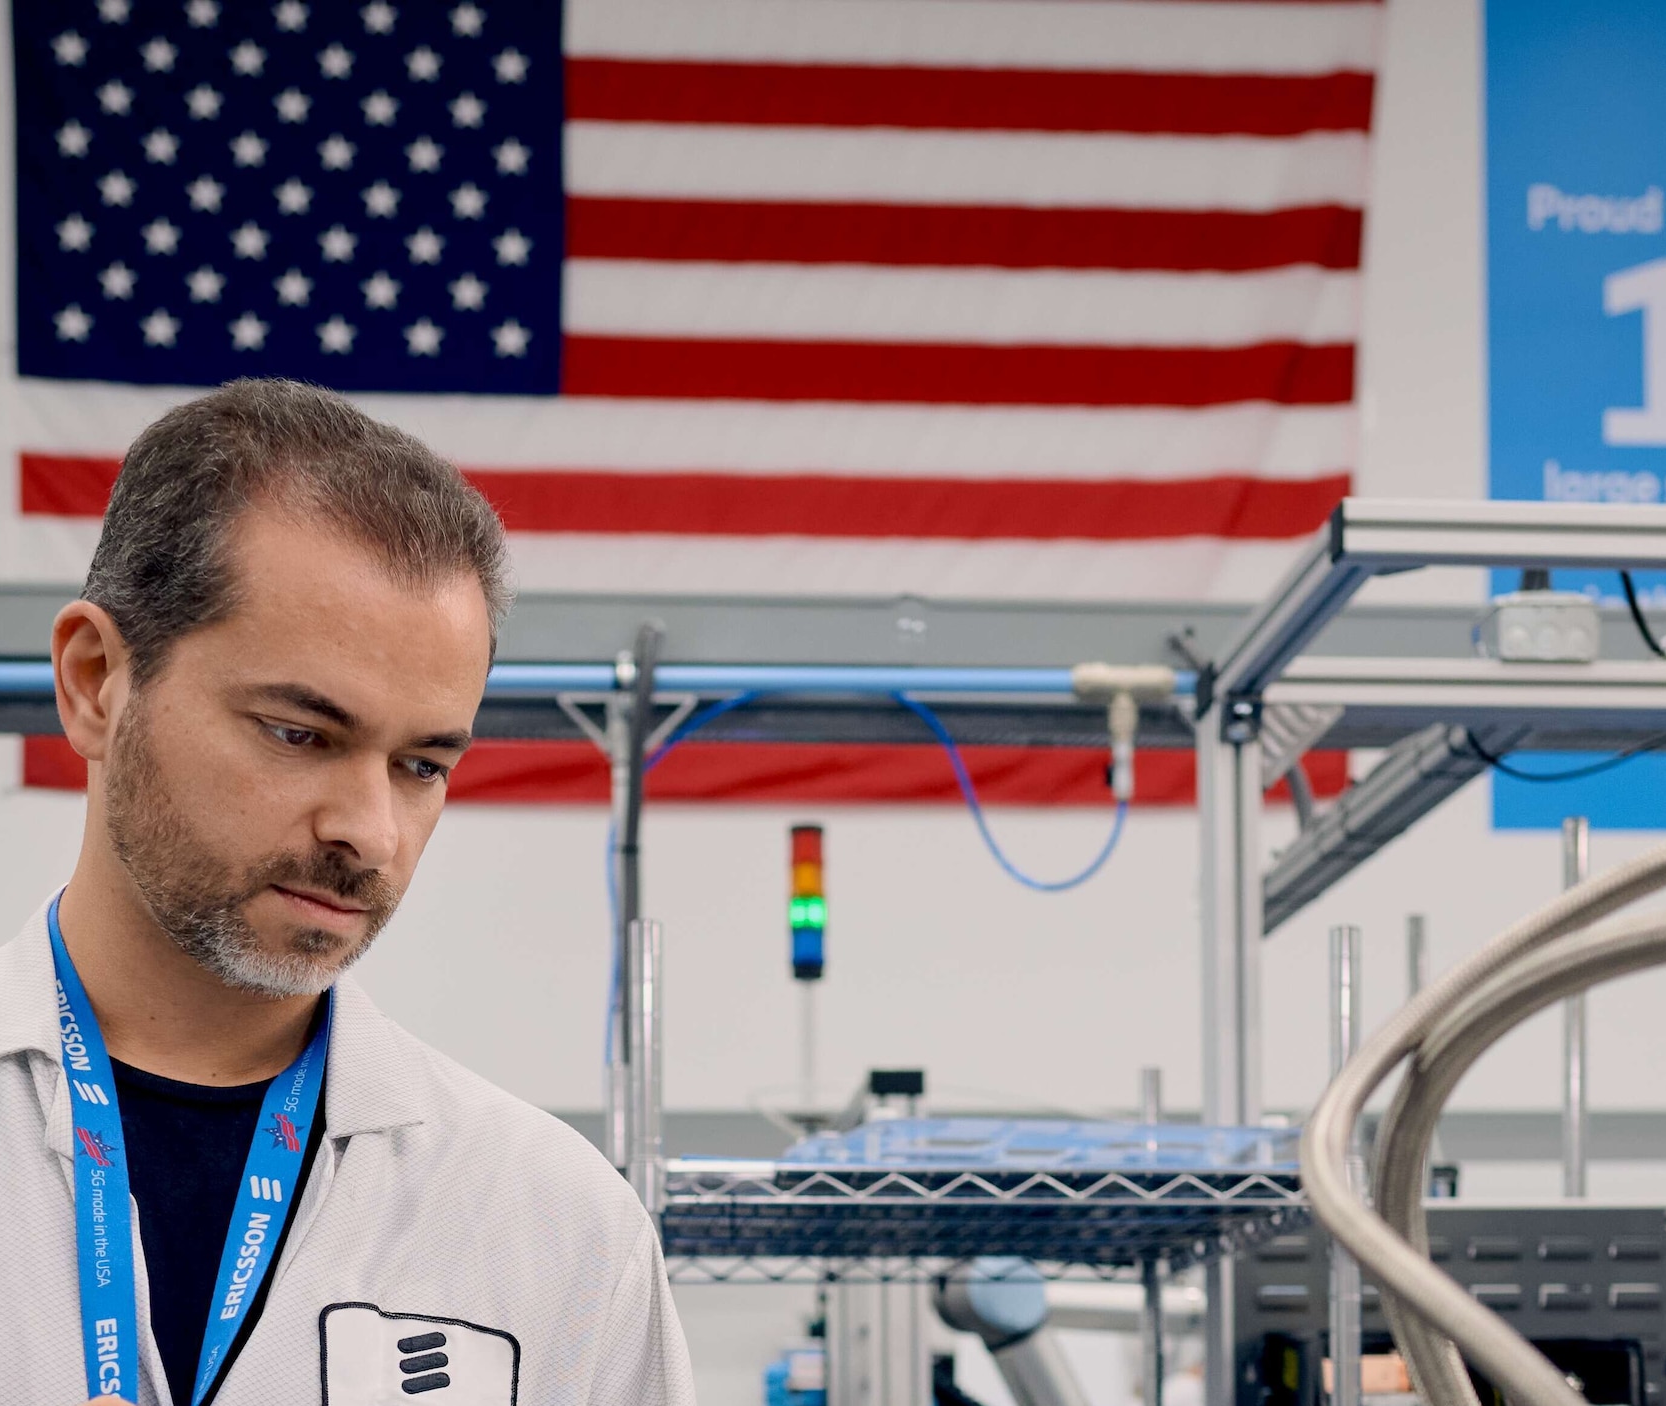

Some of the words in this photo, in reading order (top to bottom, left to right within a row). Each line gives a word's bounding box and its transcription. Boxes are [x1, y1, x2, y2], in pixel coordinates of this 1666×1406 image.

[1527, 182, 1665, 233] Proud
[291, 1068, 308, 1097] made
[283, 1096, 300, 1114] 5G
[90, 1169, 106, 1187] 5G
[92, 1188, 108, 1224] made
[94, 1224, 108, 1237] in
[94, 1239, 110, 1258] the
[95, 1259, 112, 1288] USA
[220, 1212, 272, 1321] ERICSSON
[95, 1317, 122, 1399] ERICS
